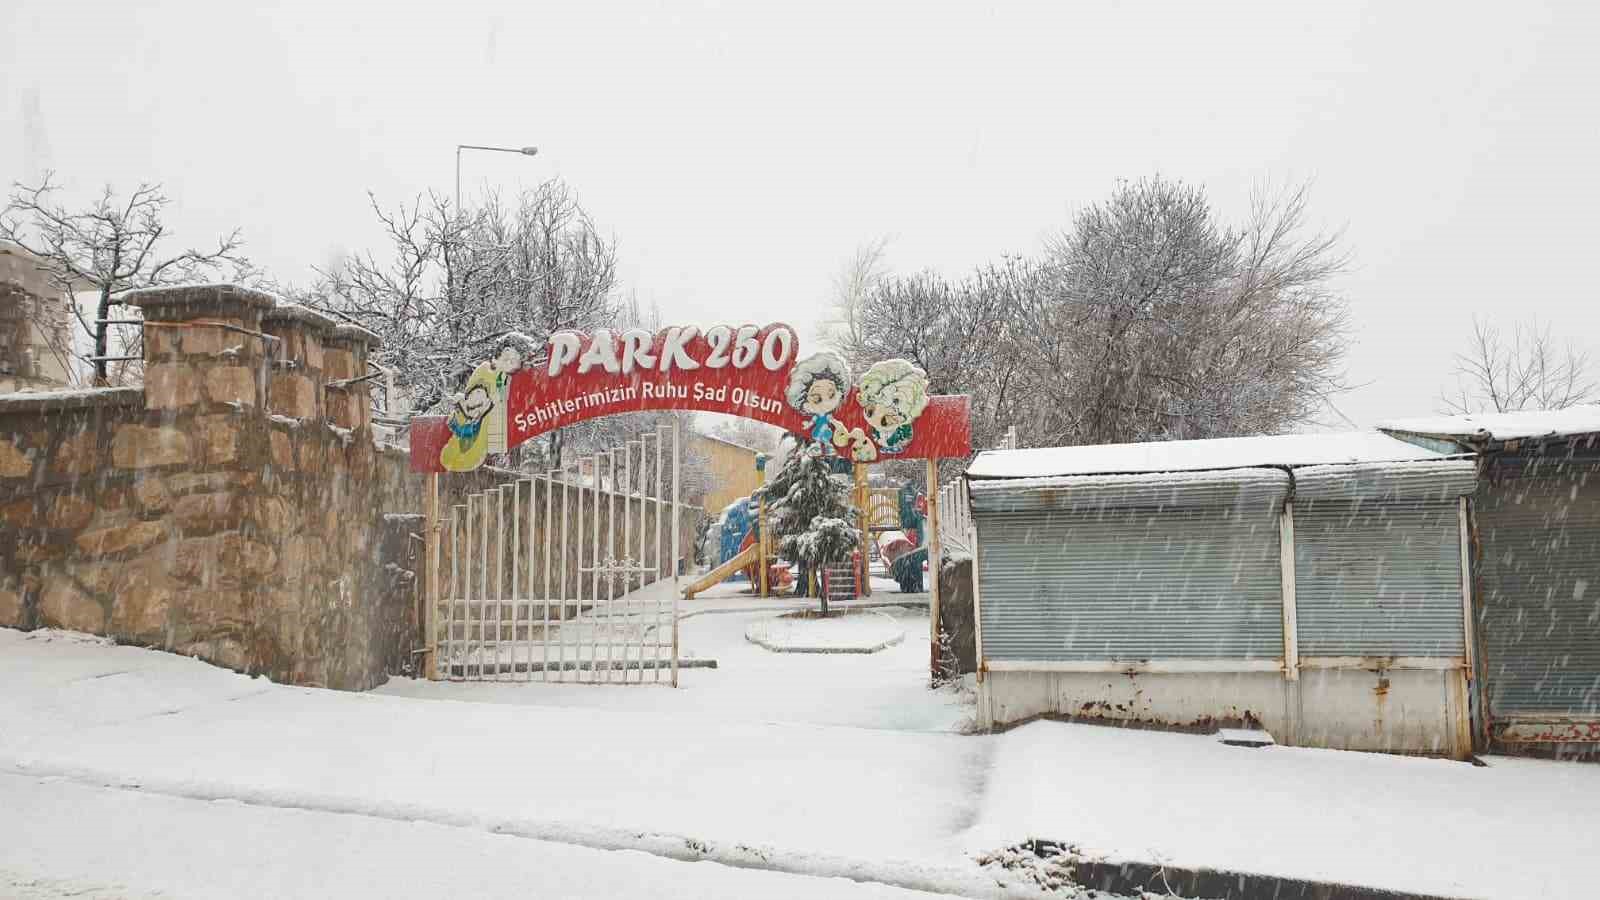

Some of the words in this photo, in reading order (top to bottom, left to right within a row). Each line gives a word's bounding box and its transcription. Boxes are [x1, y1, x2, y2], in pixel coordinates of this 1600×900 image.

[547, 326, 700, 377] PARK
[704, 325, 792, 371] 250
[514, 383, 636, 432] Şehitlerimizin
[642, 380, 688, 399] Ruhu
[693, 382, 728, 402] Şad
[731, 387, 783, 415] Olsun
